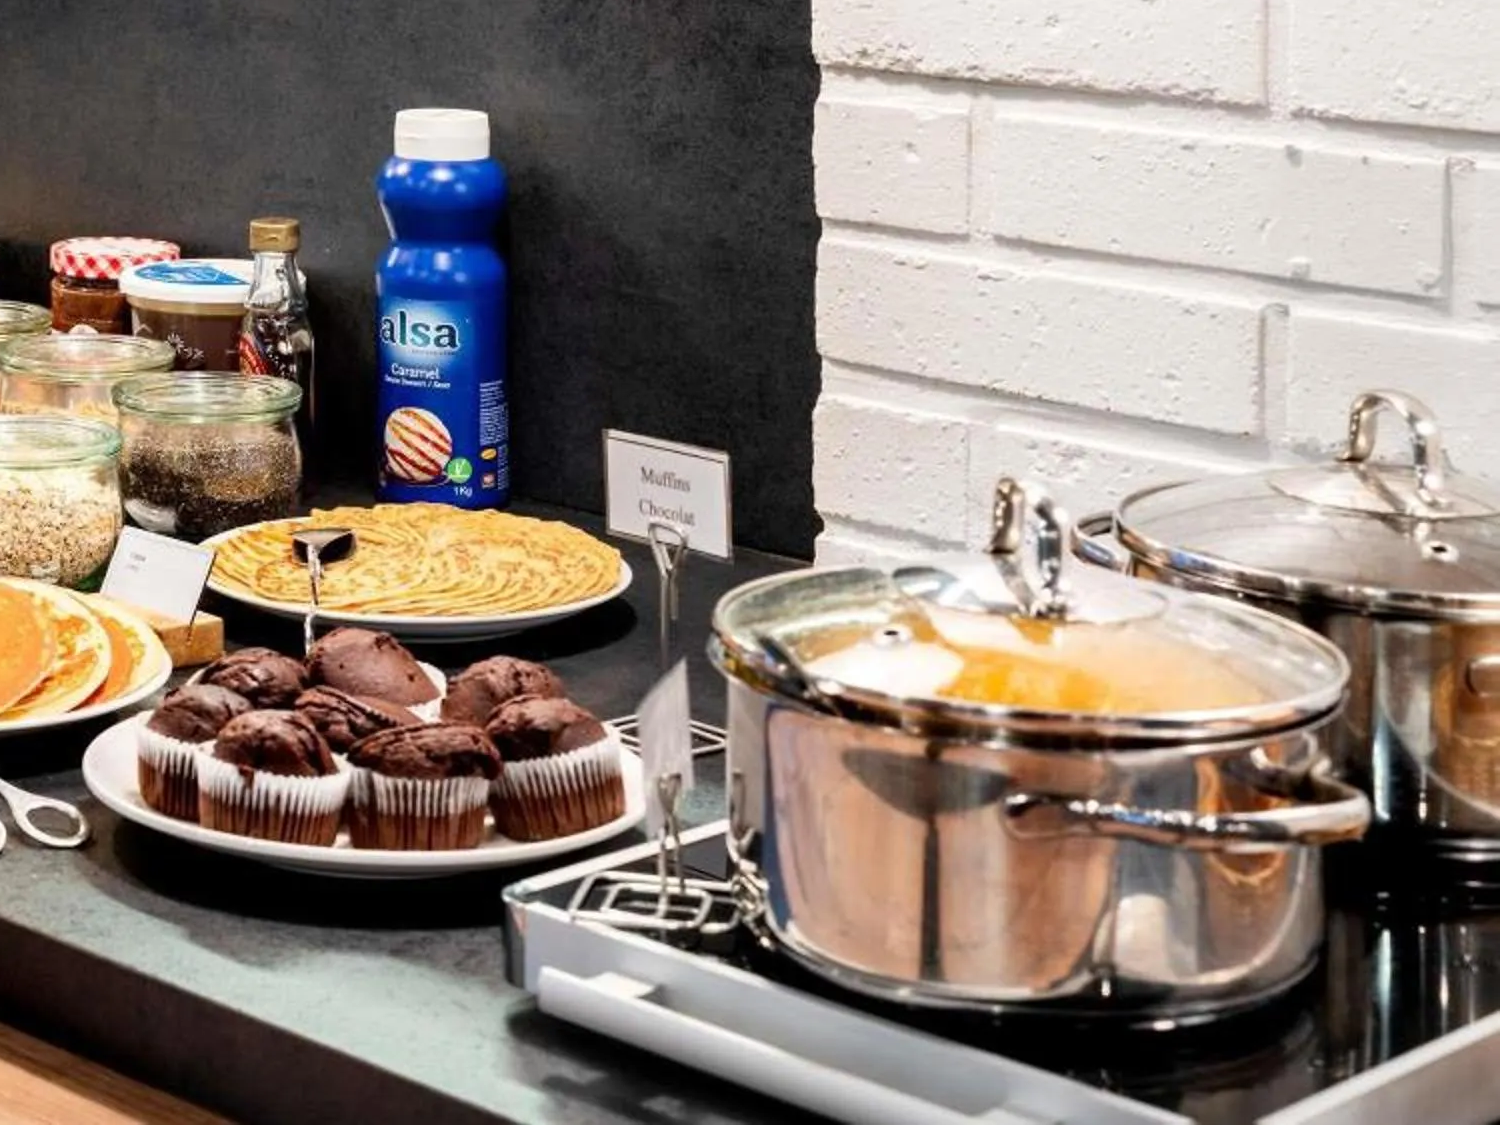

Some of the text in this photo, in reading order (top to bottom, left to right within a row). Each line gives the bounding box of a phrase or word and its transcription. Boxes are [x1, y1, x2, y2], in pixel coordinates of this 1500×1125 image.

[381, 310, 459, 350] alsa
[391, 363, 441, 380] Caramel
[640, 467, 691, 492] Muffins
[638, 499, 696, 526] Chocolat
